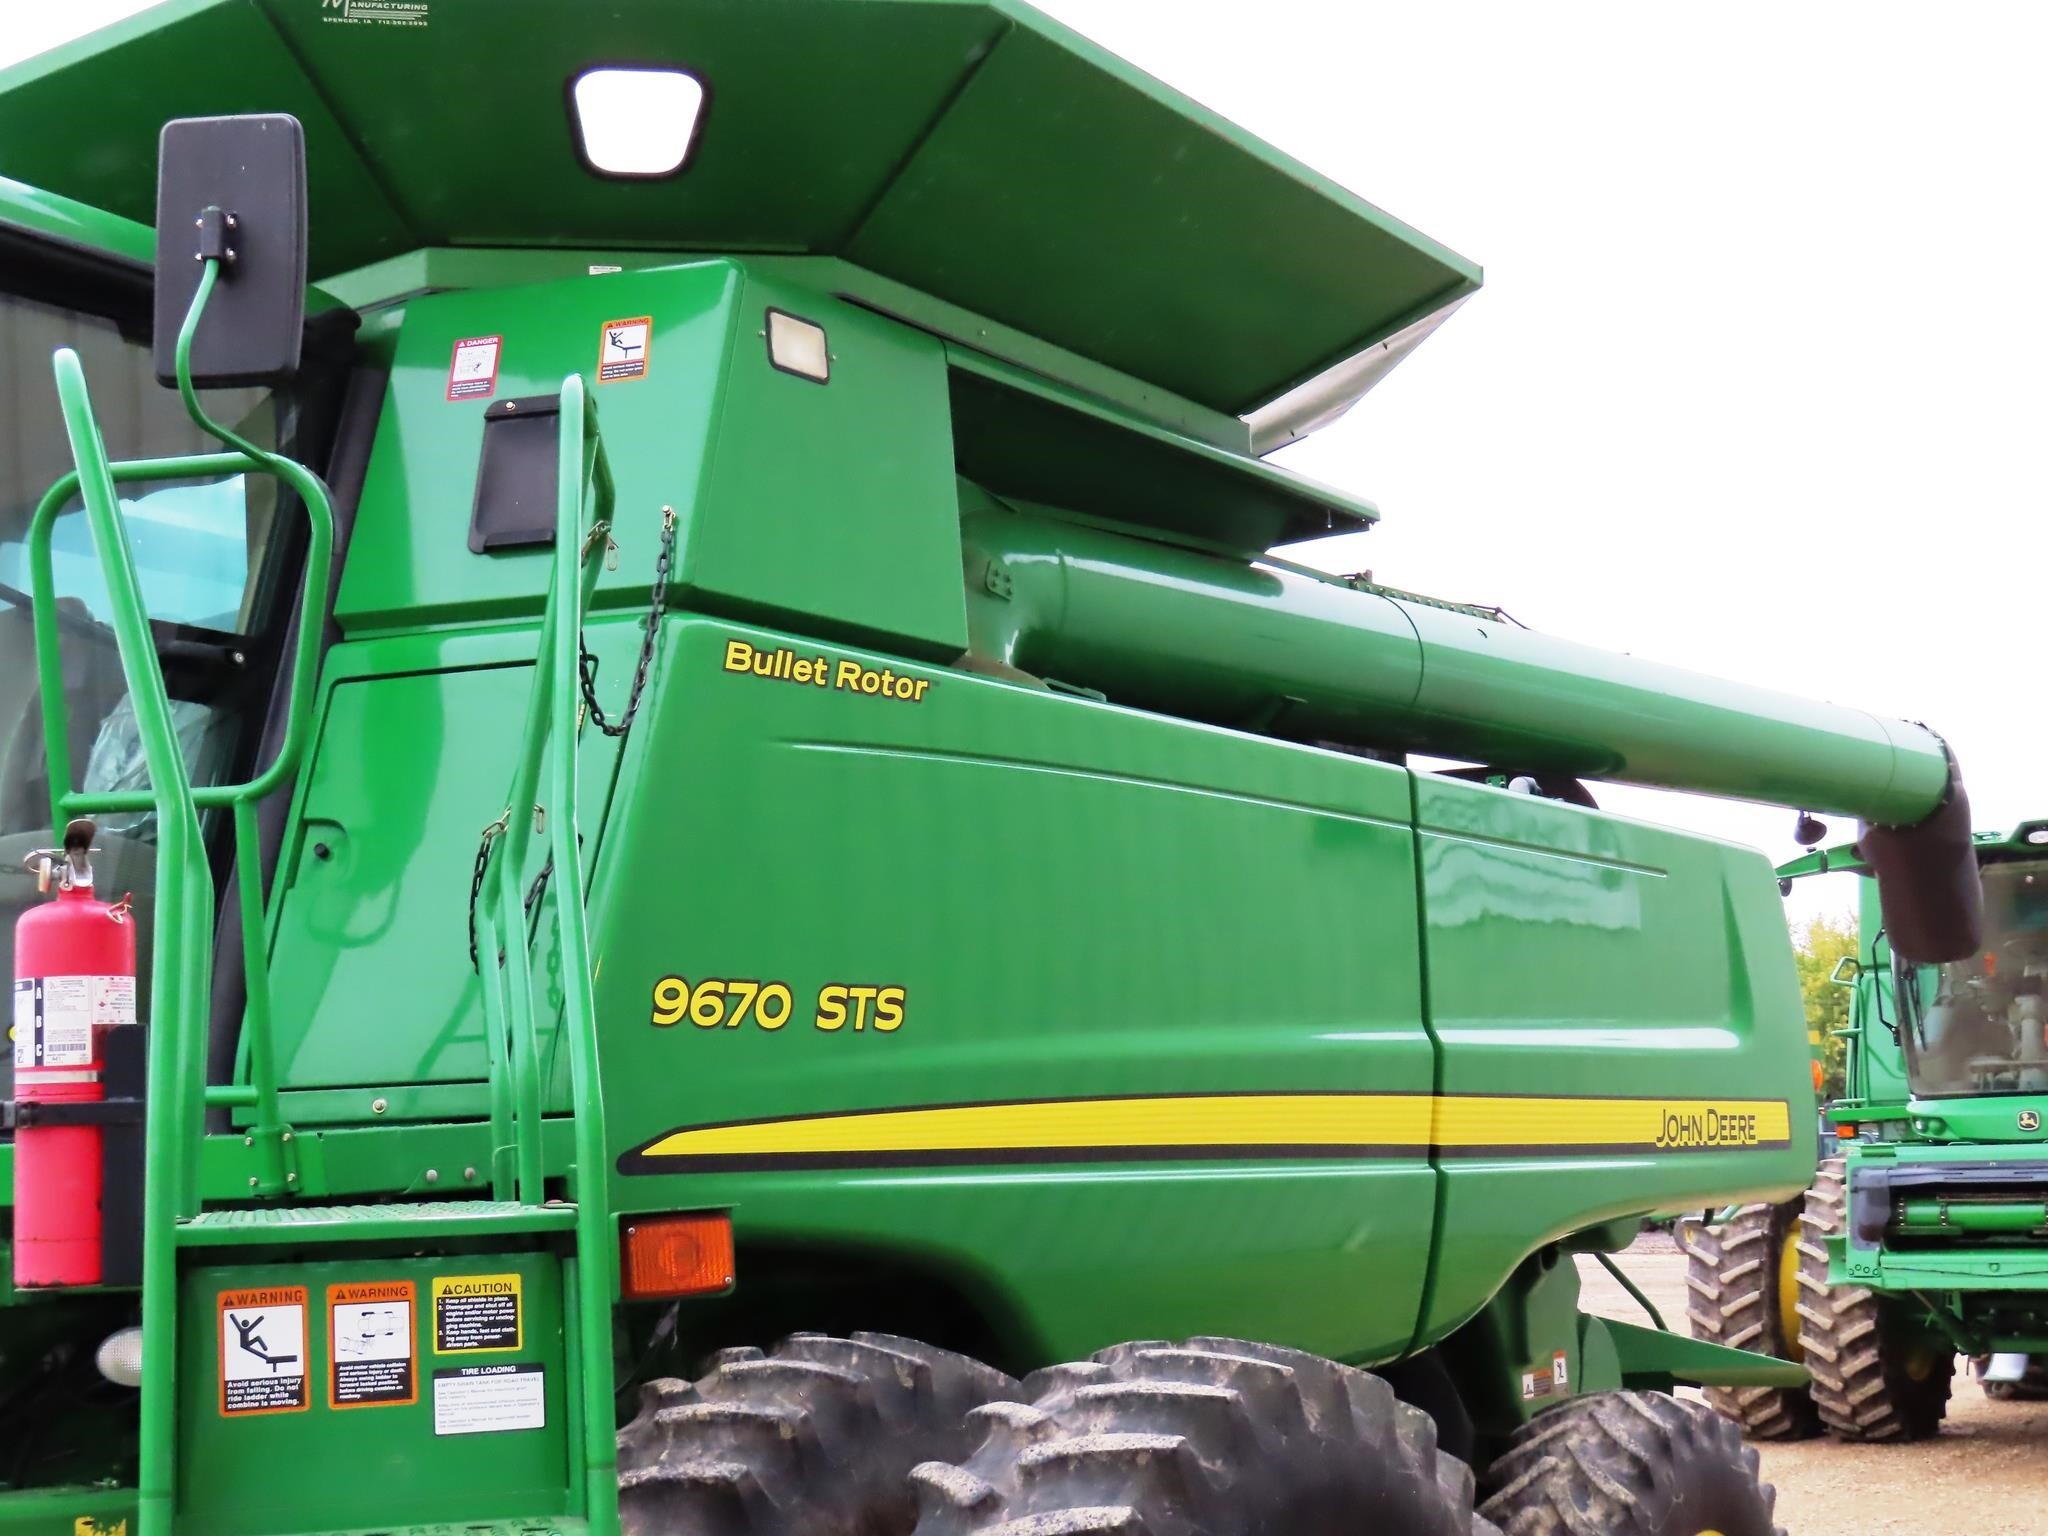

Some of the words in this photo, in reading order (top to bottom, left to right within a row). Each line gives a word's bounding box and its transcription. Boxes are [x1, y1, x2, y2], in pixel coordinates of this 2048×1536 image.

[466, 338, 498, 346] DANGER
[725, 640, 829, 687] Bullet
[835, 658, 929, 703] Rotor
[36, 986, 42, 1000] A
[652, 974, 793, 1031] 9670
[815, 982, 907, 1031] STS
[36, 1016, 42, 1028] B
[1656, 1108, 1703, 1143] JOHN
[1706, 1108, 1756, 1142] DEERE
[348, 1286, 408, 1298] WARNING
[454, 1283, 512, 1294] CAUTION
[237, 1290, 302, 1305] WARNING
[481, 1366, 516, 1374] LOADING
